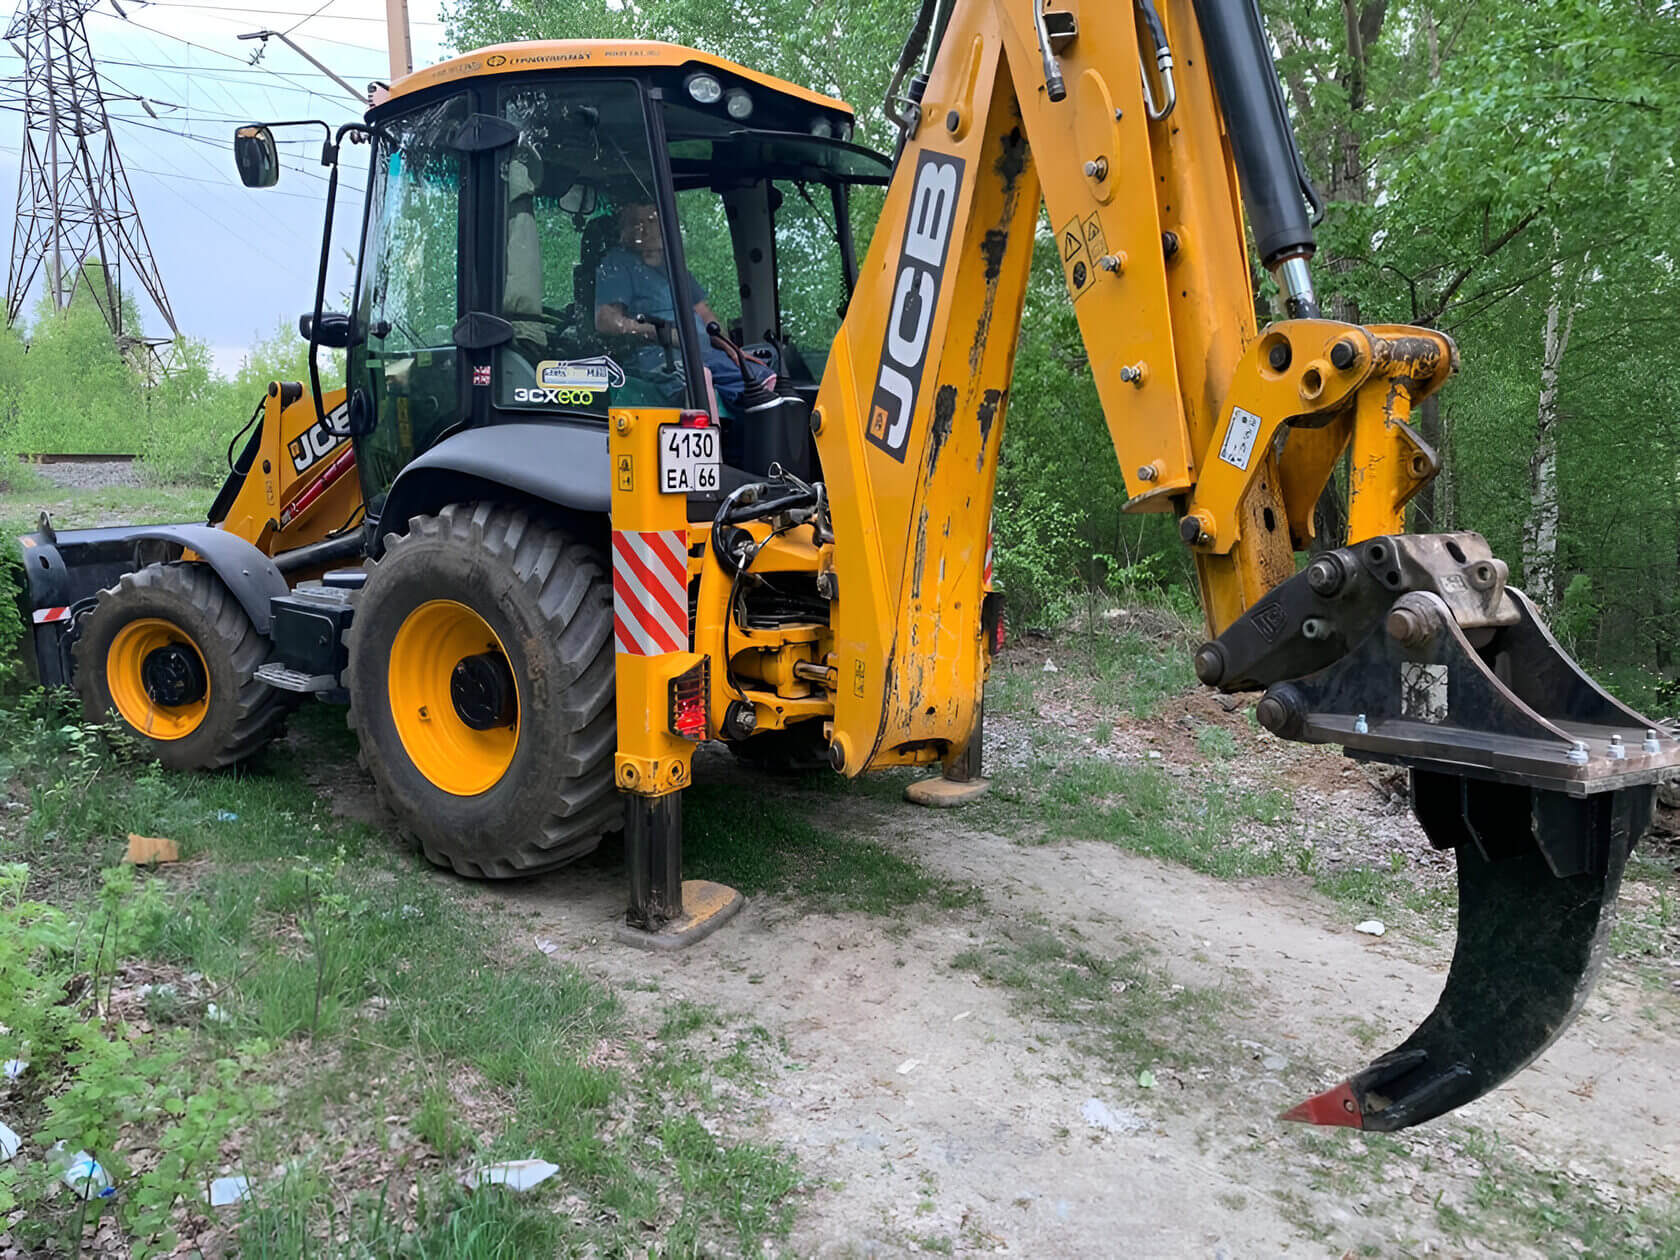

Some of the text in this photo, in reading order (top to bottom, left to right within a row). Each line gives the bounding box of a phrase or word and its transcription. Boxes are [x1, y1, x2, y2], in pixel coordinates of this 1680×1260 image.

[879, 162, 957, 449] JCB
[669, 432, 713, 458] 4130
[699, 468, 715, 487] 66
